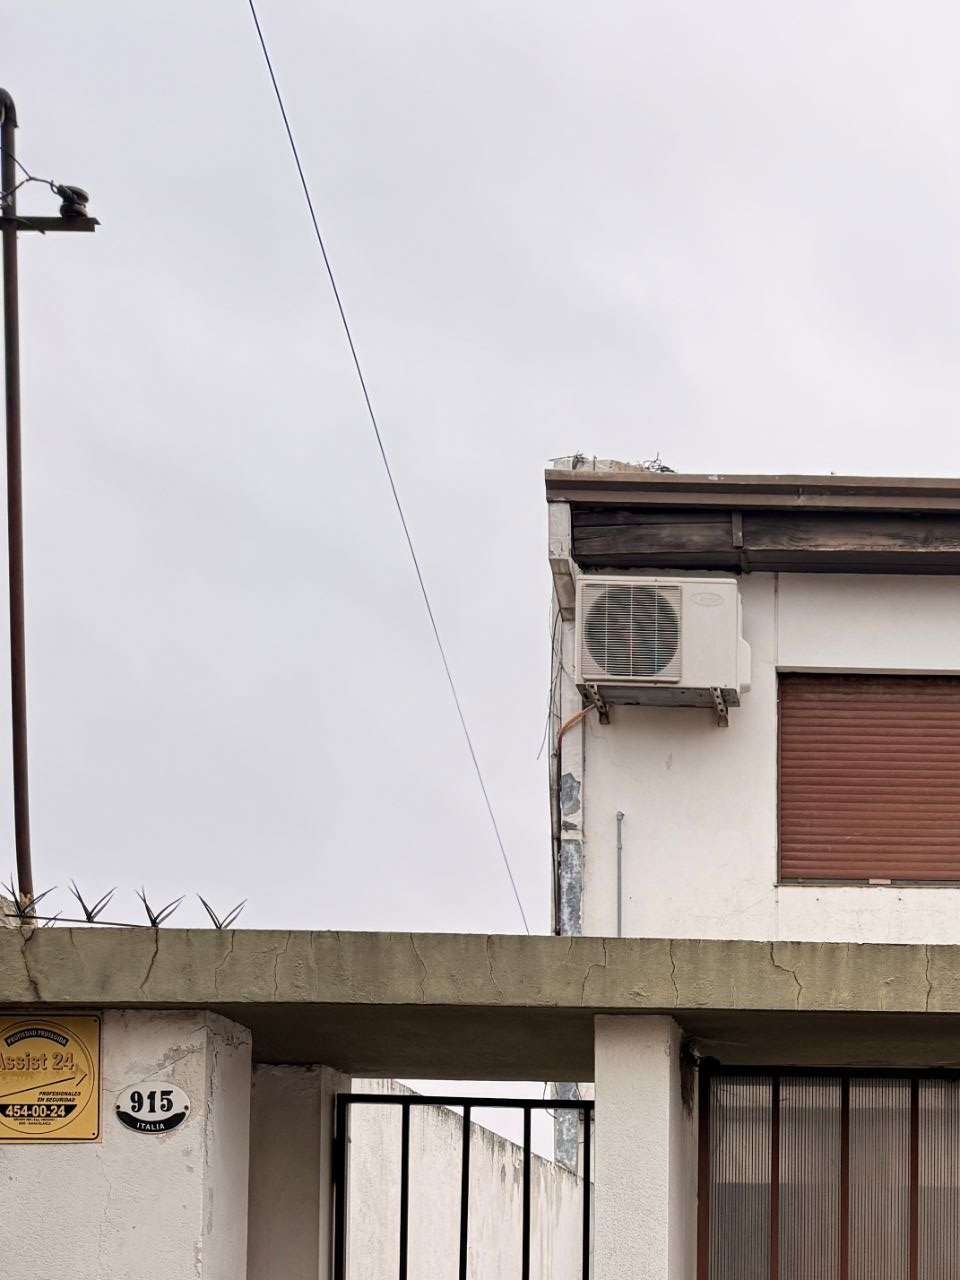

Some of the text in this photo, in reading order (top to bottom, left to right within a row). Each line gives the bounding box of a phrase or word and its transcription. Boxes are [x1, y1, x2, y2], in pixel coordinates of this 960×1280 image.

[52, 1051, 74, 1071] 24
[130, 1090, 174, 1113] 915
[5, 1104, 66, 1117] 454-00-24
[136, 1122, 165, 1131] ITALIA
